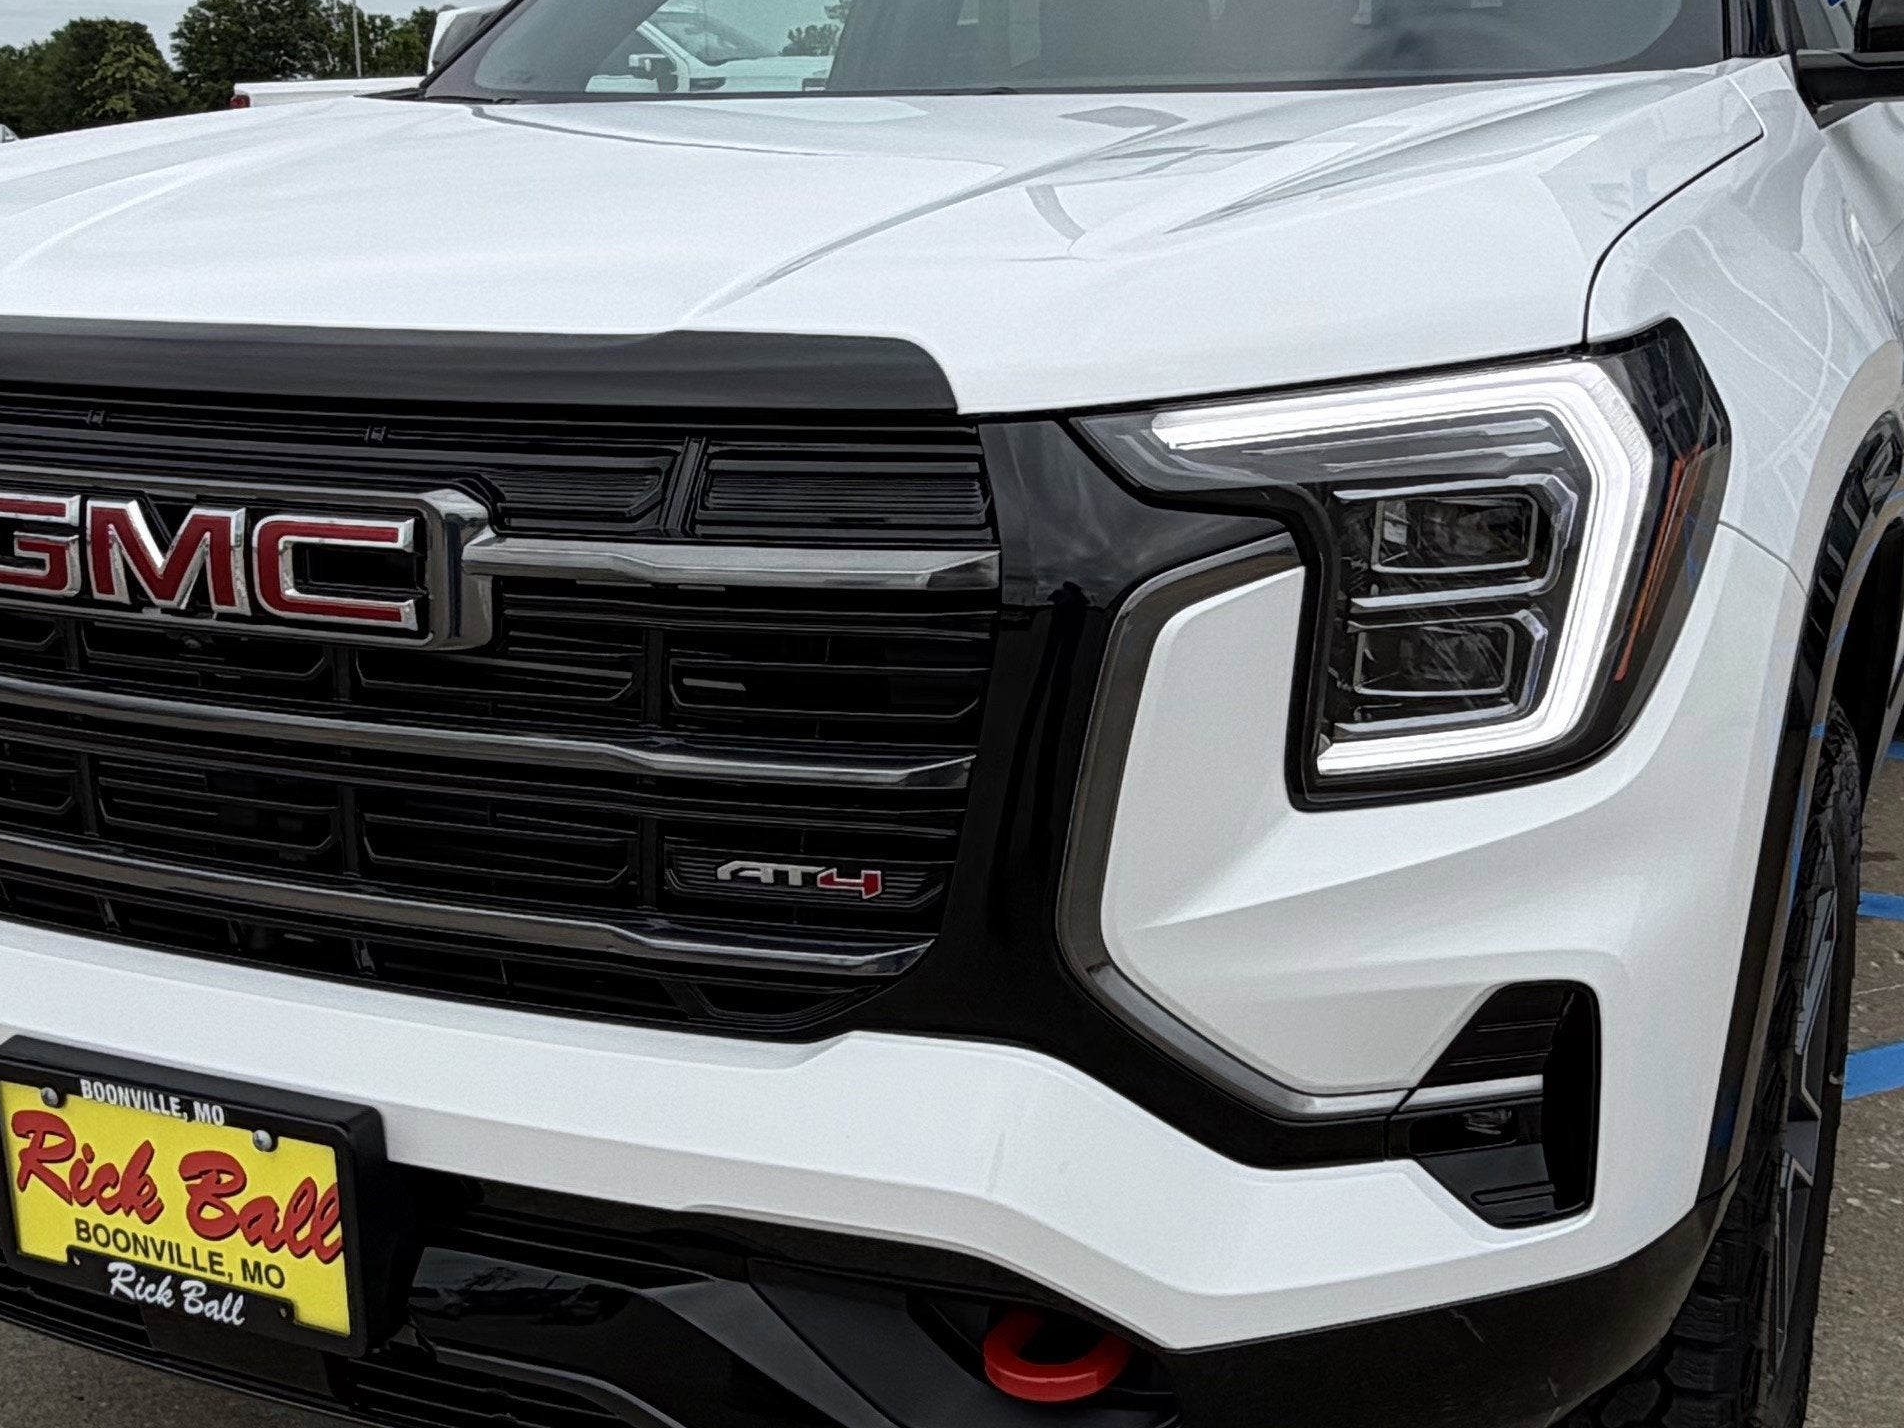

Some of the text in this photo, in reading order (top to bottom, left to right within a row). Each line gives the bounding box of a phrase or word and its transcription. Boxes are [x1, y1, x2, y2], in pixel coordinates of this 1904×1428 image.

[716, 860, 882, 900] AT4
[79, 1077, 226, 1127] BOONVILLE, MO
[10, 1109, 345, 1265] Rick Ball
[74, 1218, 286, 1290] BOONVILLE, MO
[108, 1262, 245, 1326] Rick Ball
